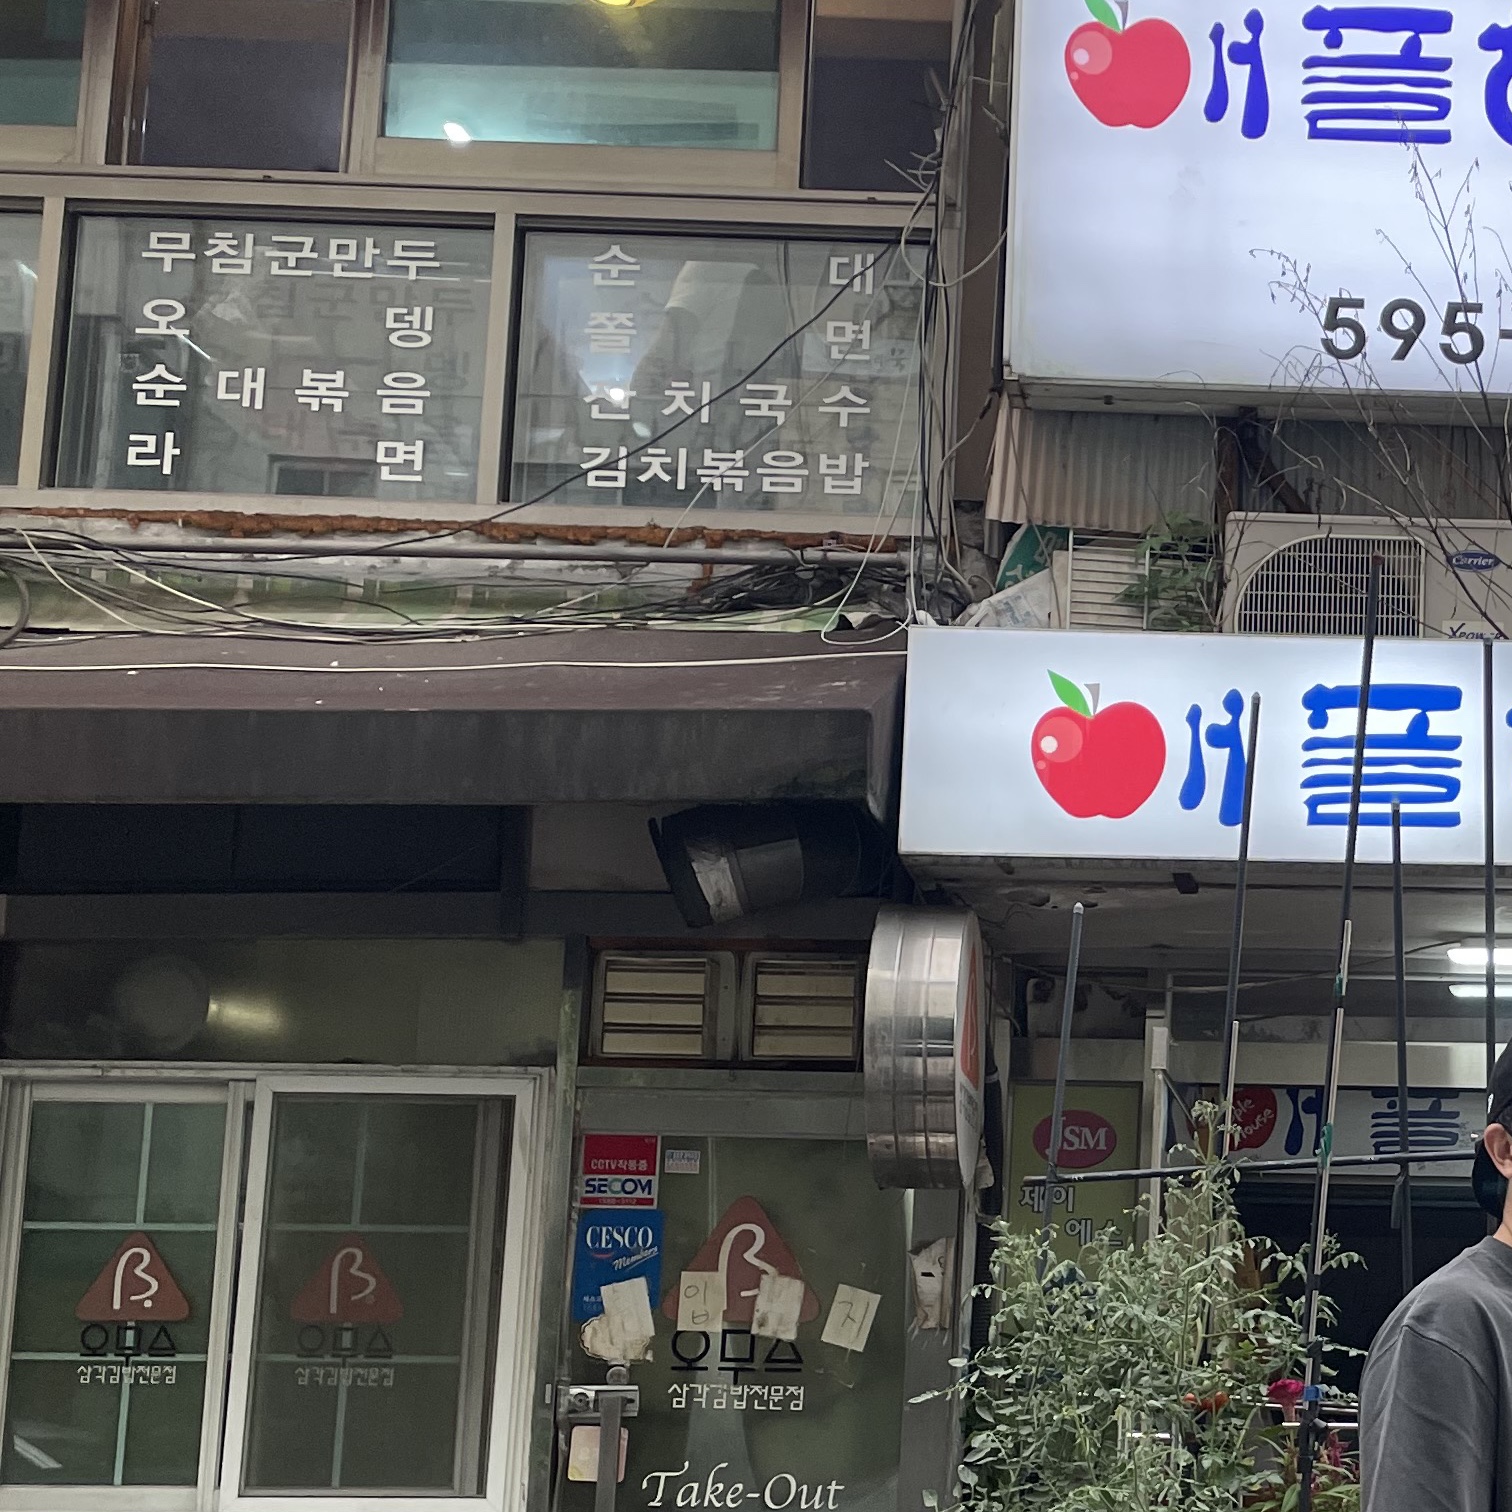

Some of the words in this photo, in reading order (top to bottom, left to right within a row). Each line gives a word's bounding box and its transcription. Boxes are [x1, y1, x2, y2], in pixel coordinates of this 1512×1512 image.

[141, 231, 441, 282] 무침군만두
[579, 443, 871, 497] 김치볶음밥
[1452, 554, 1495, 567] Carrier
[584, 1177, 652, 1196] SECOM
[586, 1226, 653, 1250] CESCO
[77, 1365, 177, 1385] 삼각김밥전문점
[294, 1366, 395, 1387] 삼각김밥전문점
[667, 1383, 805, 1411] 삼각김밥전문점
[641, 1460, 845, 1510] Take-Out
